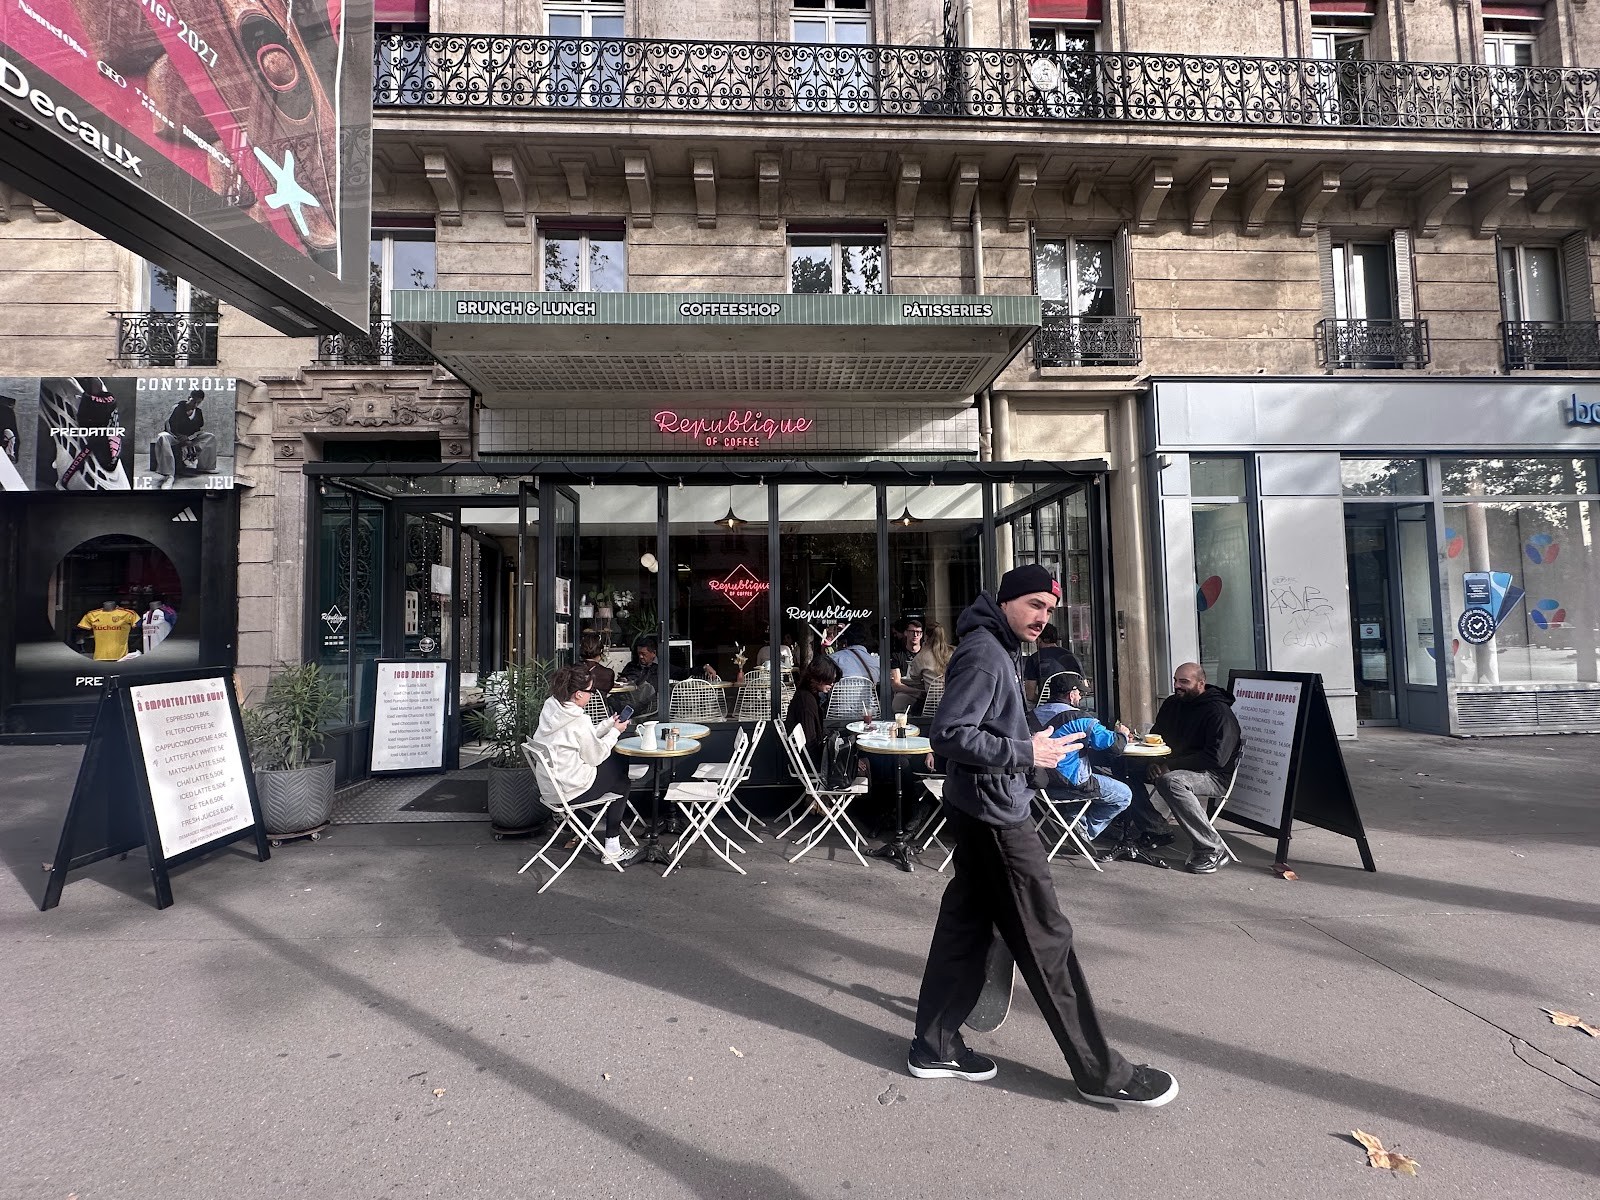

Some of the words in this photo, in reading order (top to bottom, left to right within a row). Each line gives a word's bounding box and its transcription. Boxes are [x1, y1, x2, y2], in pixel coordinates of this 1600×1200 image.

[177, 19, 218, 68] 2027
[97, 60, 127, 88] GEO
[0, 56, 143, 178] Decaux
[457, 301, 522, 315] BRUNCH
[525, 302, 540, 315] &
[542, 302, 596, 316] LUNCH
[679, 302, 781, 316] COFFEESHOP
[902, 301, 993, 318] PÂTISSERIES
[136, 376, 237, 391] CONTRÔLE
[50, 427, 126, 437] PREDATOR
[654, 410, 813, 440] Republique
[706, 437, 718, 447] OF
[724, 437, 760, 447] COFFEE
[133, 476, 152, 490] LE
[205, 475, 234, 490] JEU
[786, 605, 872, 622] Republique
[206, 691, 225, 702] AWAY
[165, 713, 195, 724] ESPRESSO
[165, 727, 186, 737] FILTER
[186, 723, 207, 733] COFFEE
[168, 764, 195, 777] MATCHA
